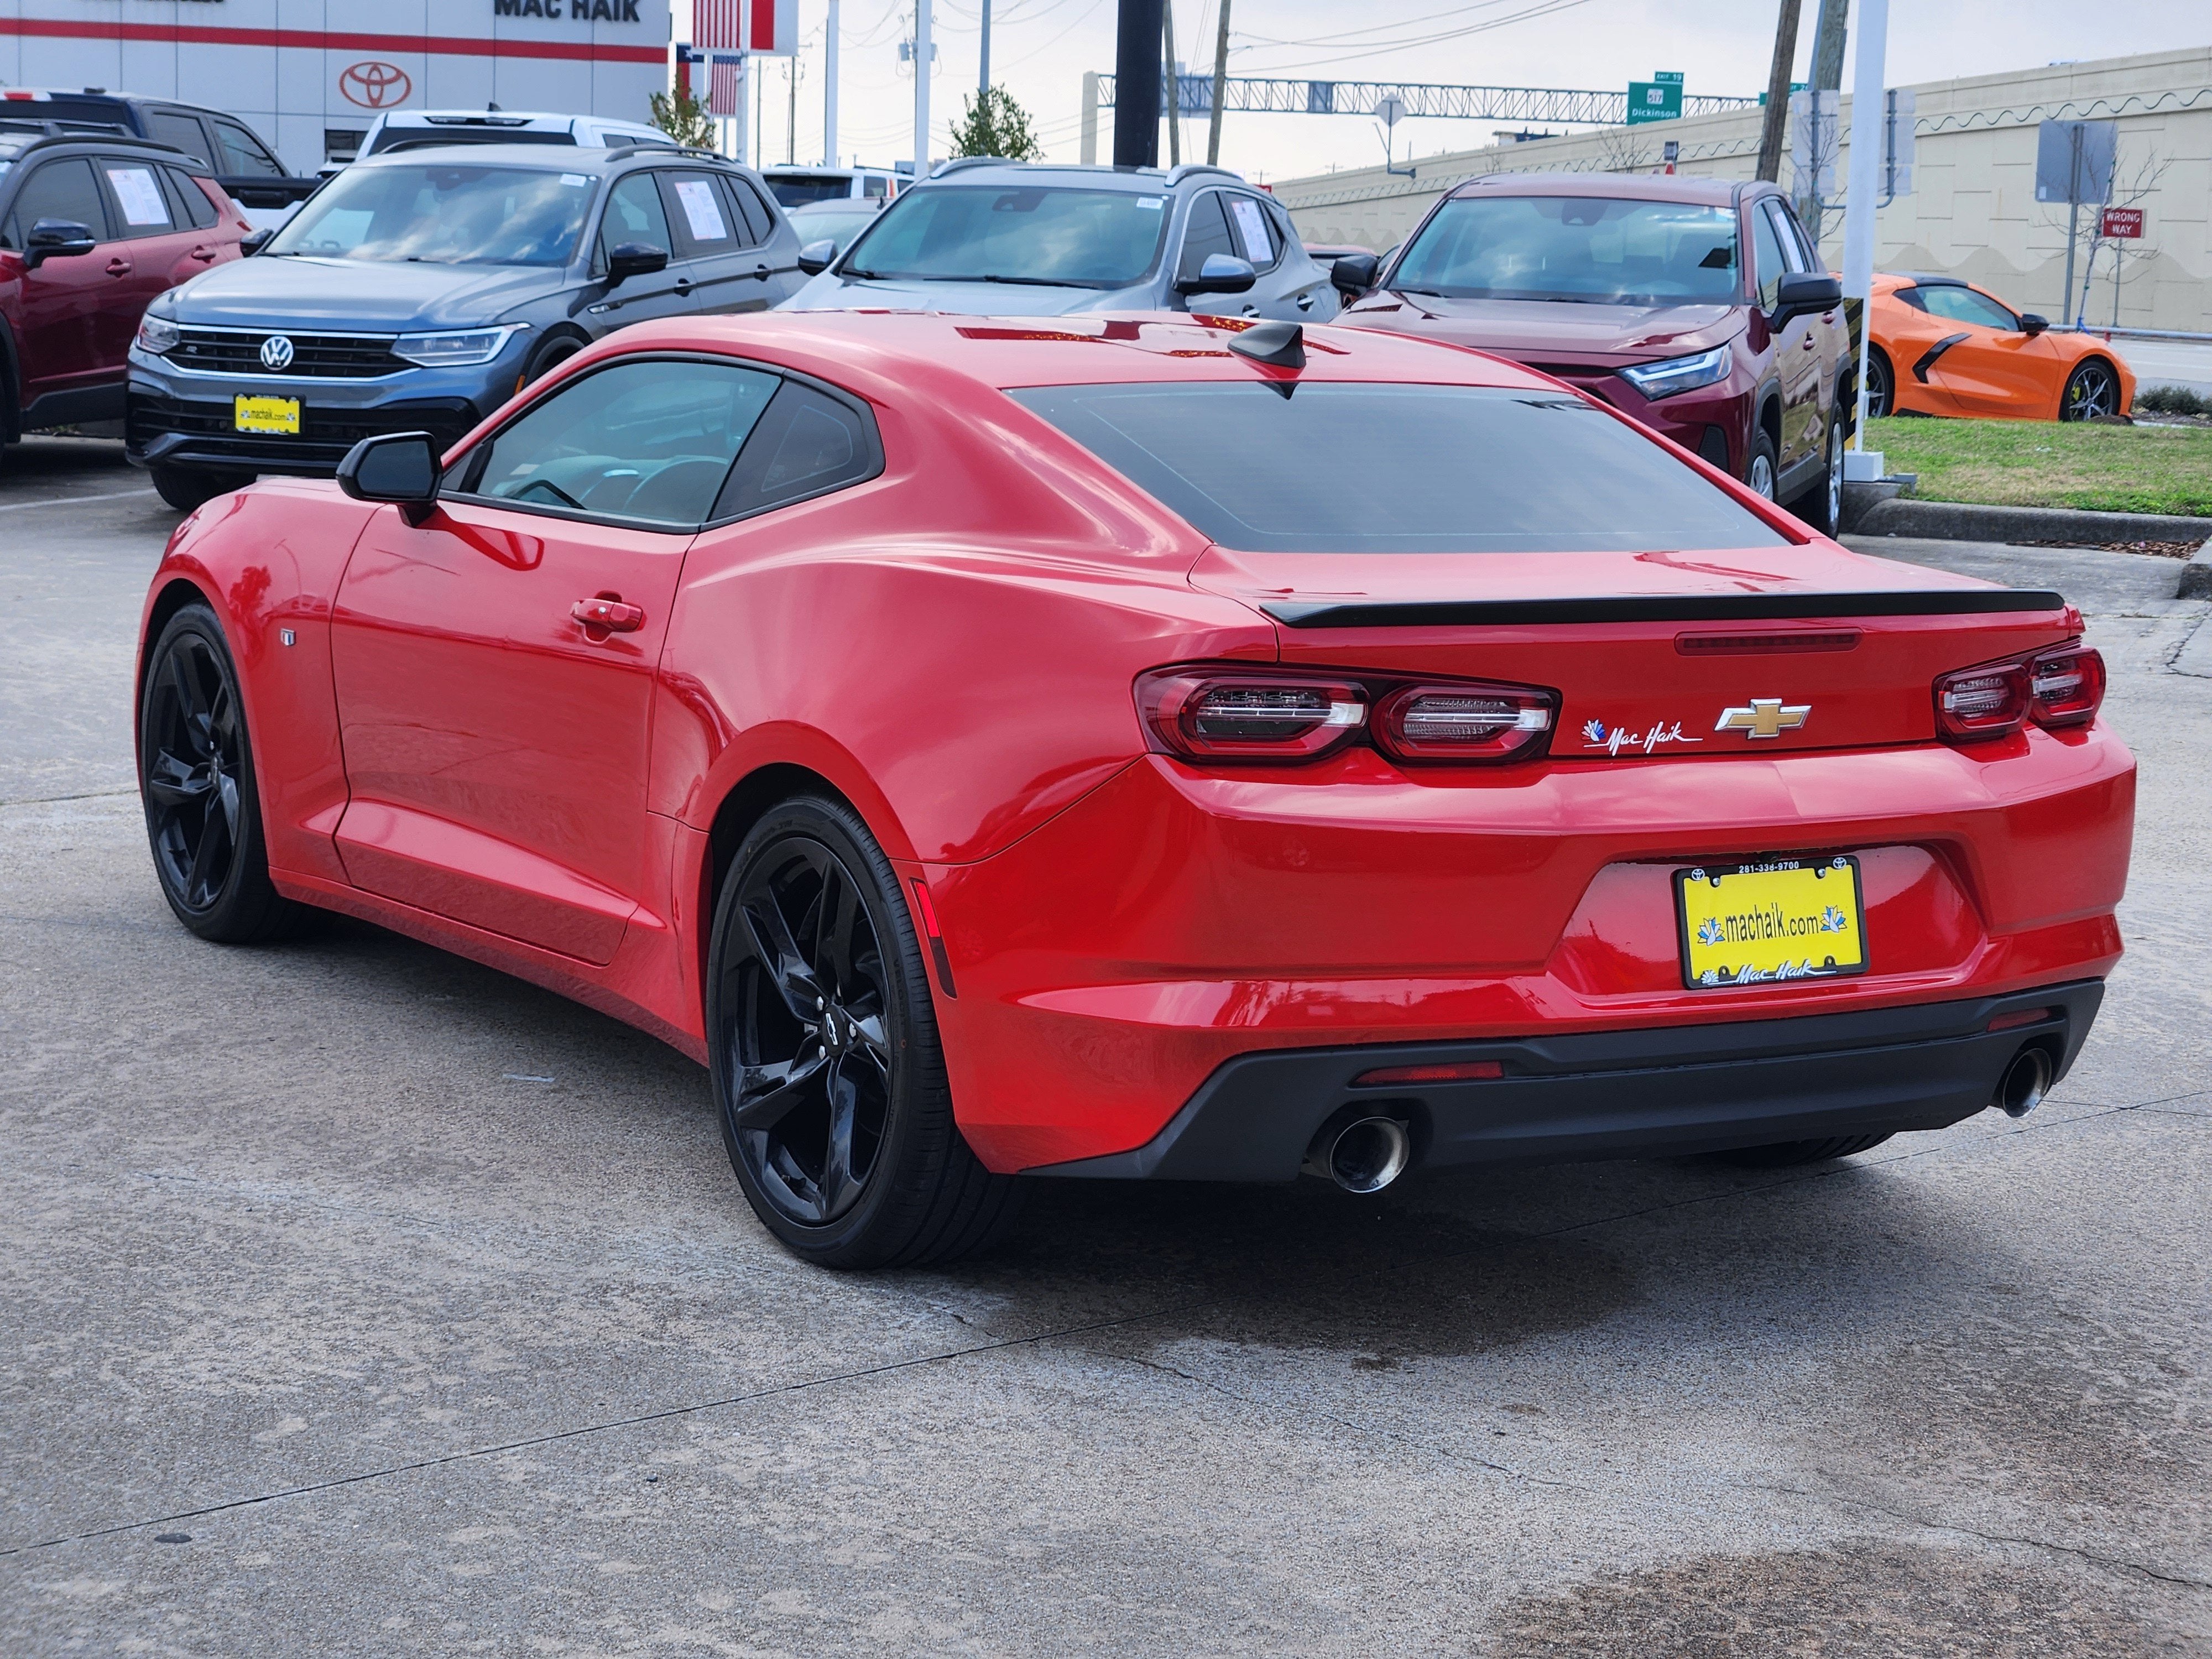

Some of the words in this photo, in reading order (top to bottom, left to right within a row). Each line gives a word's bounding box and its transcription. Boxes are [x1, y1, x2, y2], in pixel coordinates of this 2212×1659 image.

[495, 0, 561, 18] MAC
[572, 0, 640, 22] HAIK
[1632, 107, 1677, 118] Dickinson
[2106, 212, 2140, 223] WRONG
[2112, 224, 2132, 234] WAY
[1603, 727, 1643, 757] Mac
[1643, 721, 1704, 754] Haik
[1725, 902, 1819, 943] machaik.com
[1731, 963, 1774, 984] Mac
[1774, 958, 1838, 980] Haik
